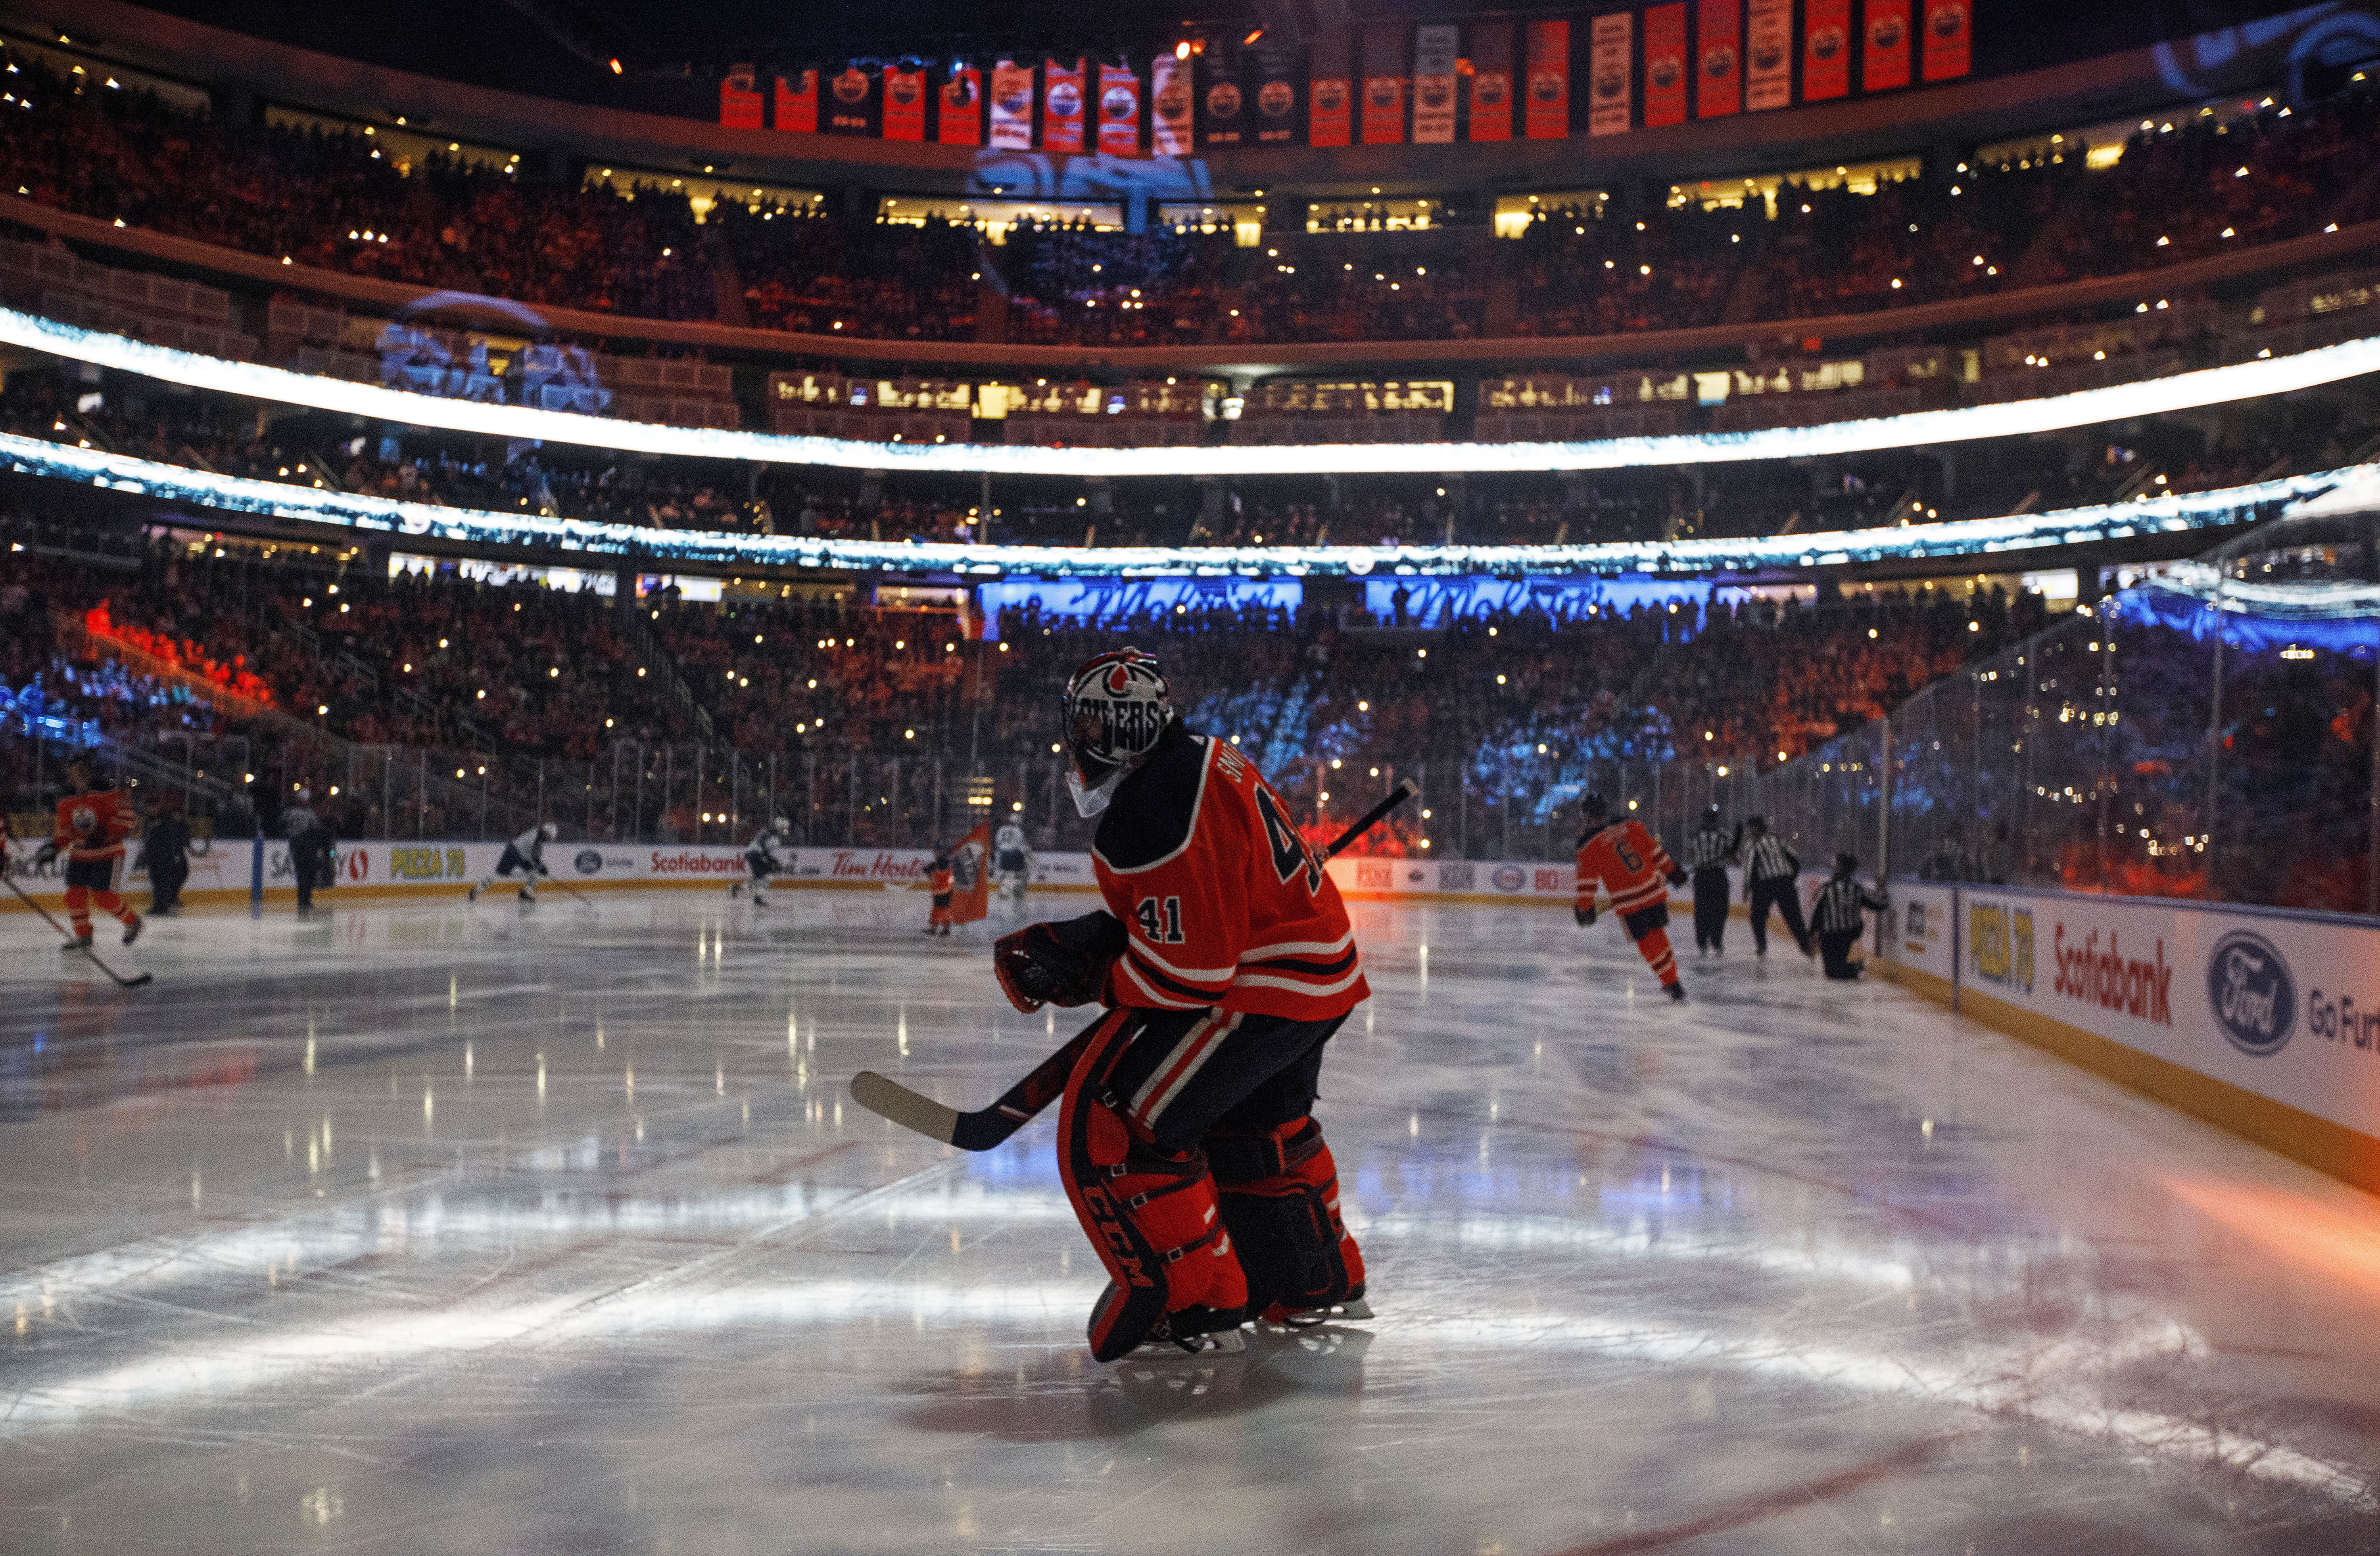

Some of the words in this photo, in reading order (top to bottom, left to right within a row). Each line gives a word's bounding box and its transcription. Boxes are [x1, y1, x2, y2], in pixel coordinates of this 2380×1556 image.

[391, 848, 443, 877] PIZZA
[651, 852, 746, 873] Scotiabank
[832, 852, 867, 875] Tim
[1136, 895, 1185, 944] 41
[2055, 922, 2172, 1027] Scotiabank
[2222, 947, 2278, 1037] Ford
[2310, 988, 2337, 1039] Go
[1082, 1186, 1154, 1287] CCM
